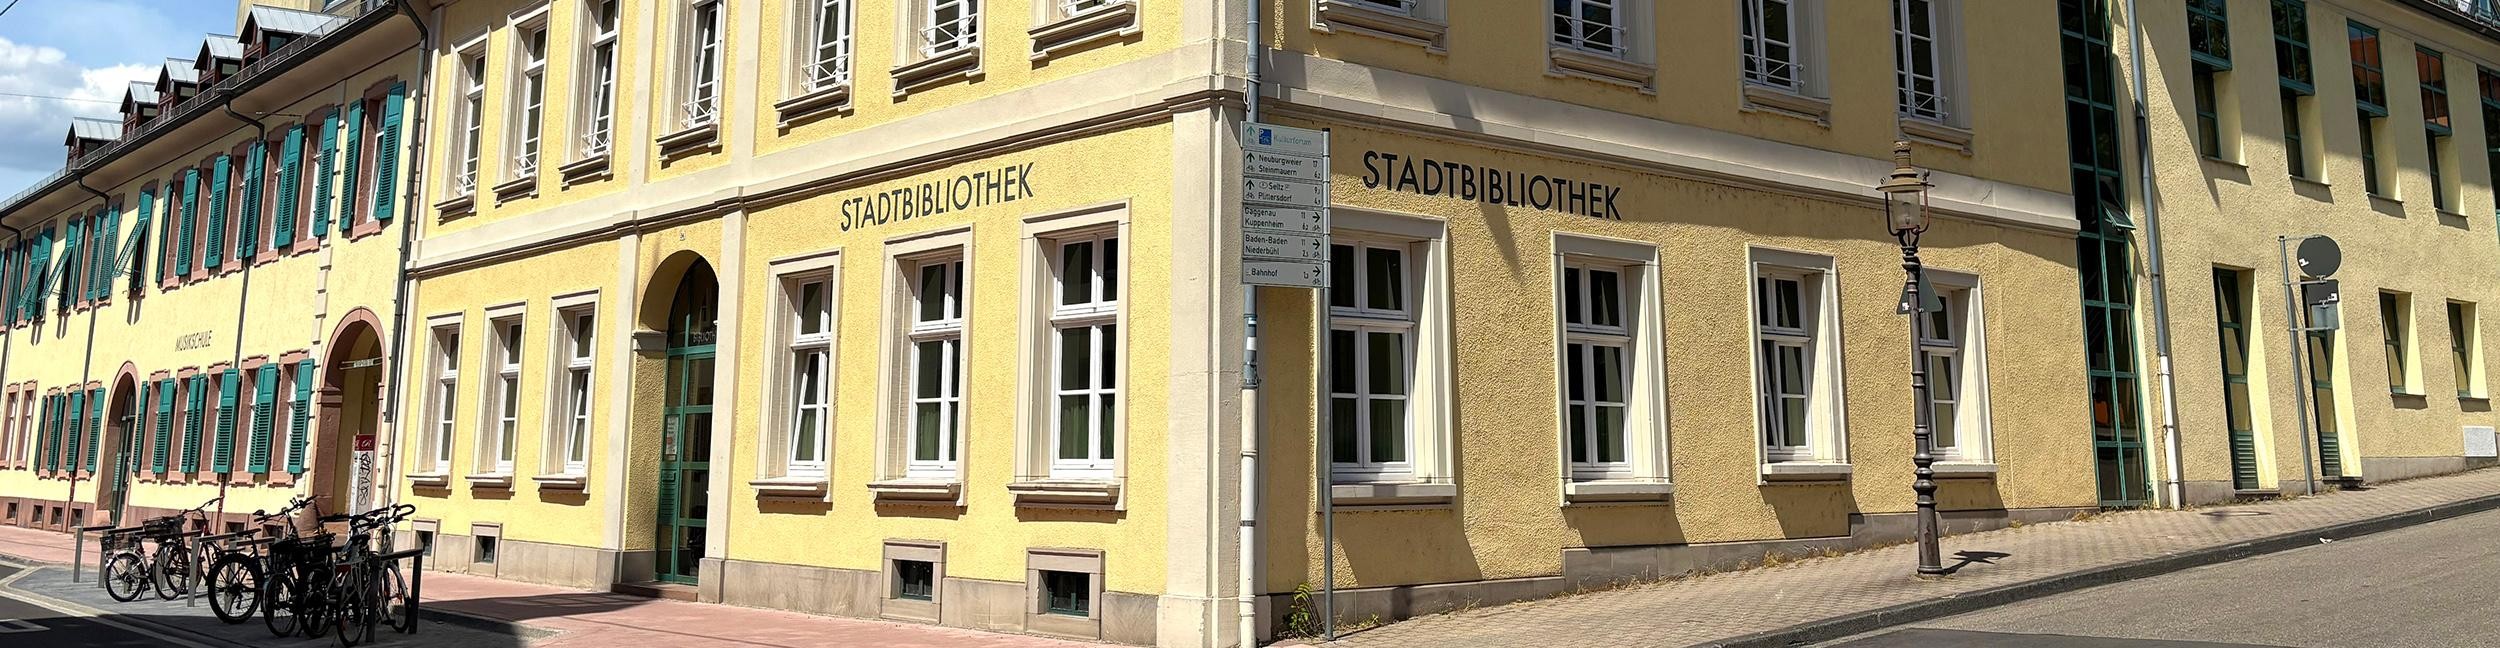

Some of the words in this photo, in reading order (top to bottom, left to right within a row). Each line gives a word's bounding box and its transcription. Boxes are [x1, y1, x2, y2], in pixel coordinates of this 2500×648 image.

[1258, 154, 1302, 166] Neuburgweier
[1258, 164, 1296, 175] Steinmauern
[1362, 150, 1621, 220] STADTBIBLIOTHEK
[840, 161, 1034, 232] STADTBIBLIOTHEK
[1244, 207, 1276, 217] Gaggenau
[1244, 217, 1284, 228] Kuppenheim
[1245, 233, 1288, 244] Baden-Baden
[1245, 245, 1279, 255] Niederbühl
[1251, 268, 1278, 277] Bahnhof
[174, 329, 213, 353] MUSIKSCHULE
